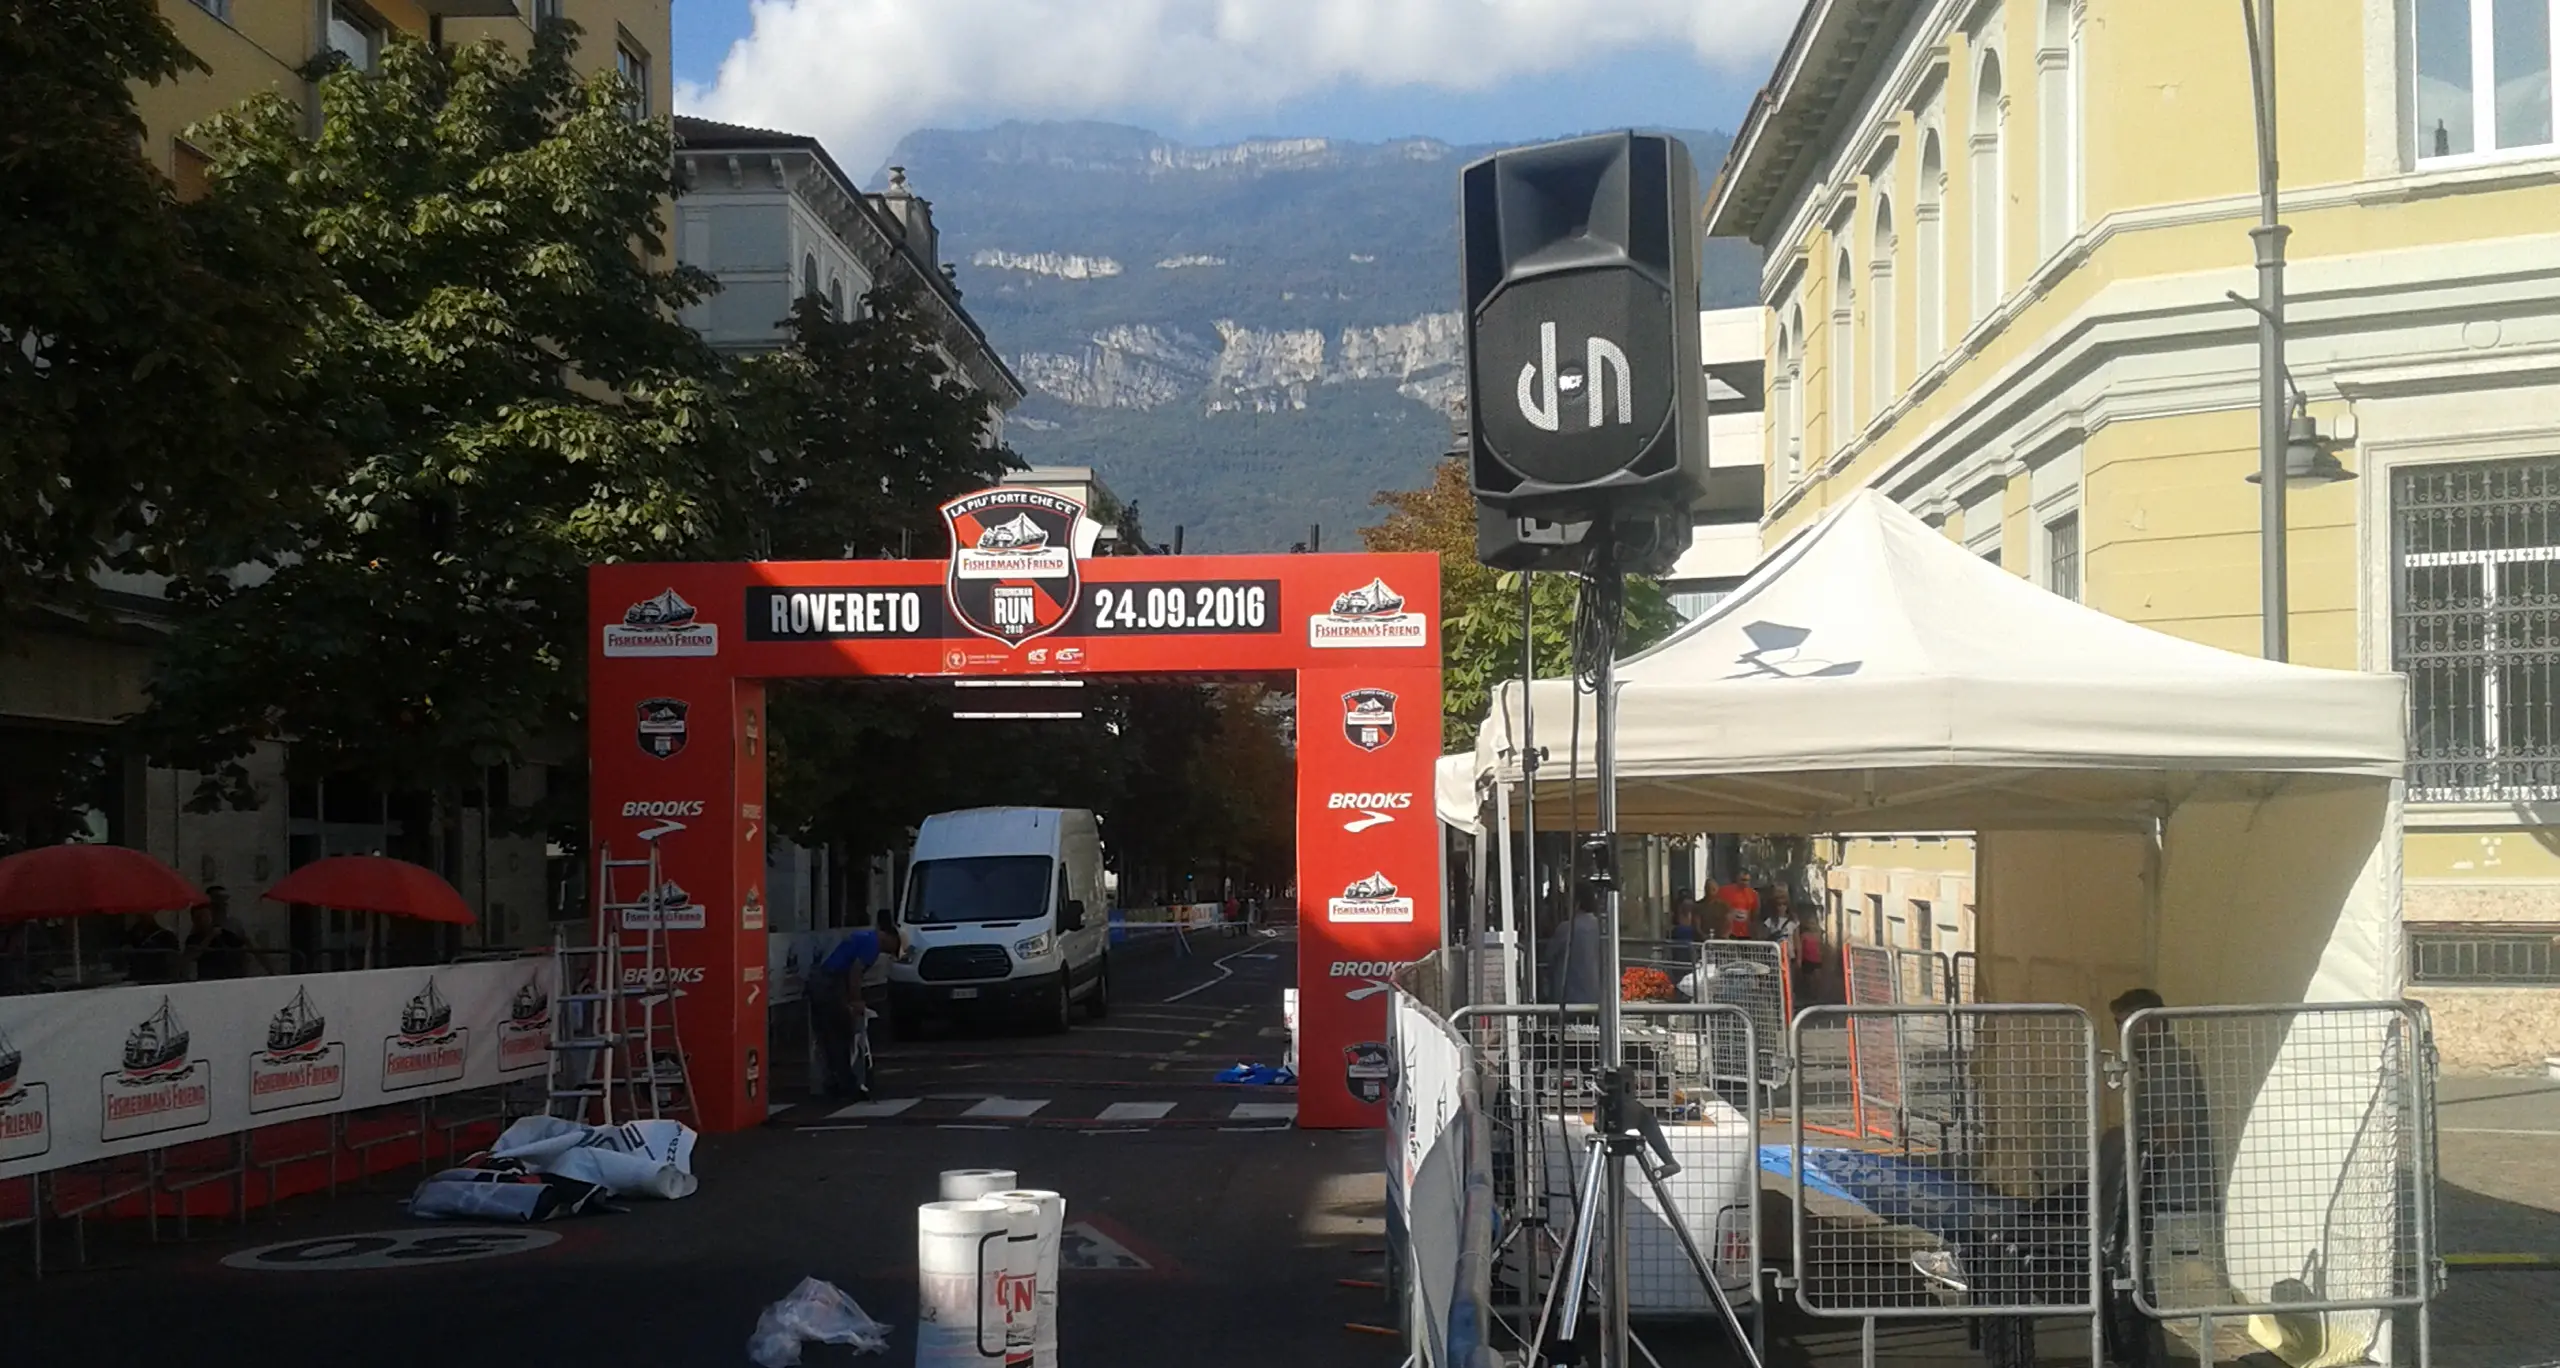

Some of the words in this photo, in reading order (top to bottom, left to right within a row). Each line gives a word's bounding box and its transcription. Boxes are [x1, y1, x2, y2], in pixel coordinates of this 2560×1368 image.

[950, 504, 966, 518] LA
[991, 494, 1027, 504] FORTE
[1029, 494, 1052, 506] CHE
[1027, 557, 1064, 570] FRIEND
[770, 592, 920, 634] ROVERETO
[994, 597, 1034, 624] RUN
[1095, 586, 1266, 629] 24.09.2016
[1382, 622, 1421, 637] FRIEND
[675, 632, 713, 647] FRIEND
[622, 800, 705, 816] BROOKS
[1328, 792, 1412, 808] BROOKS
